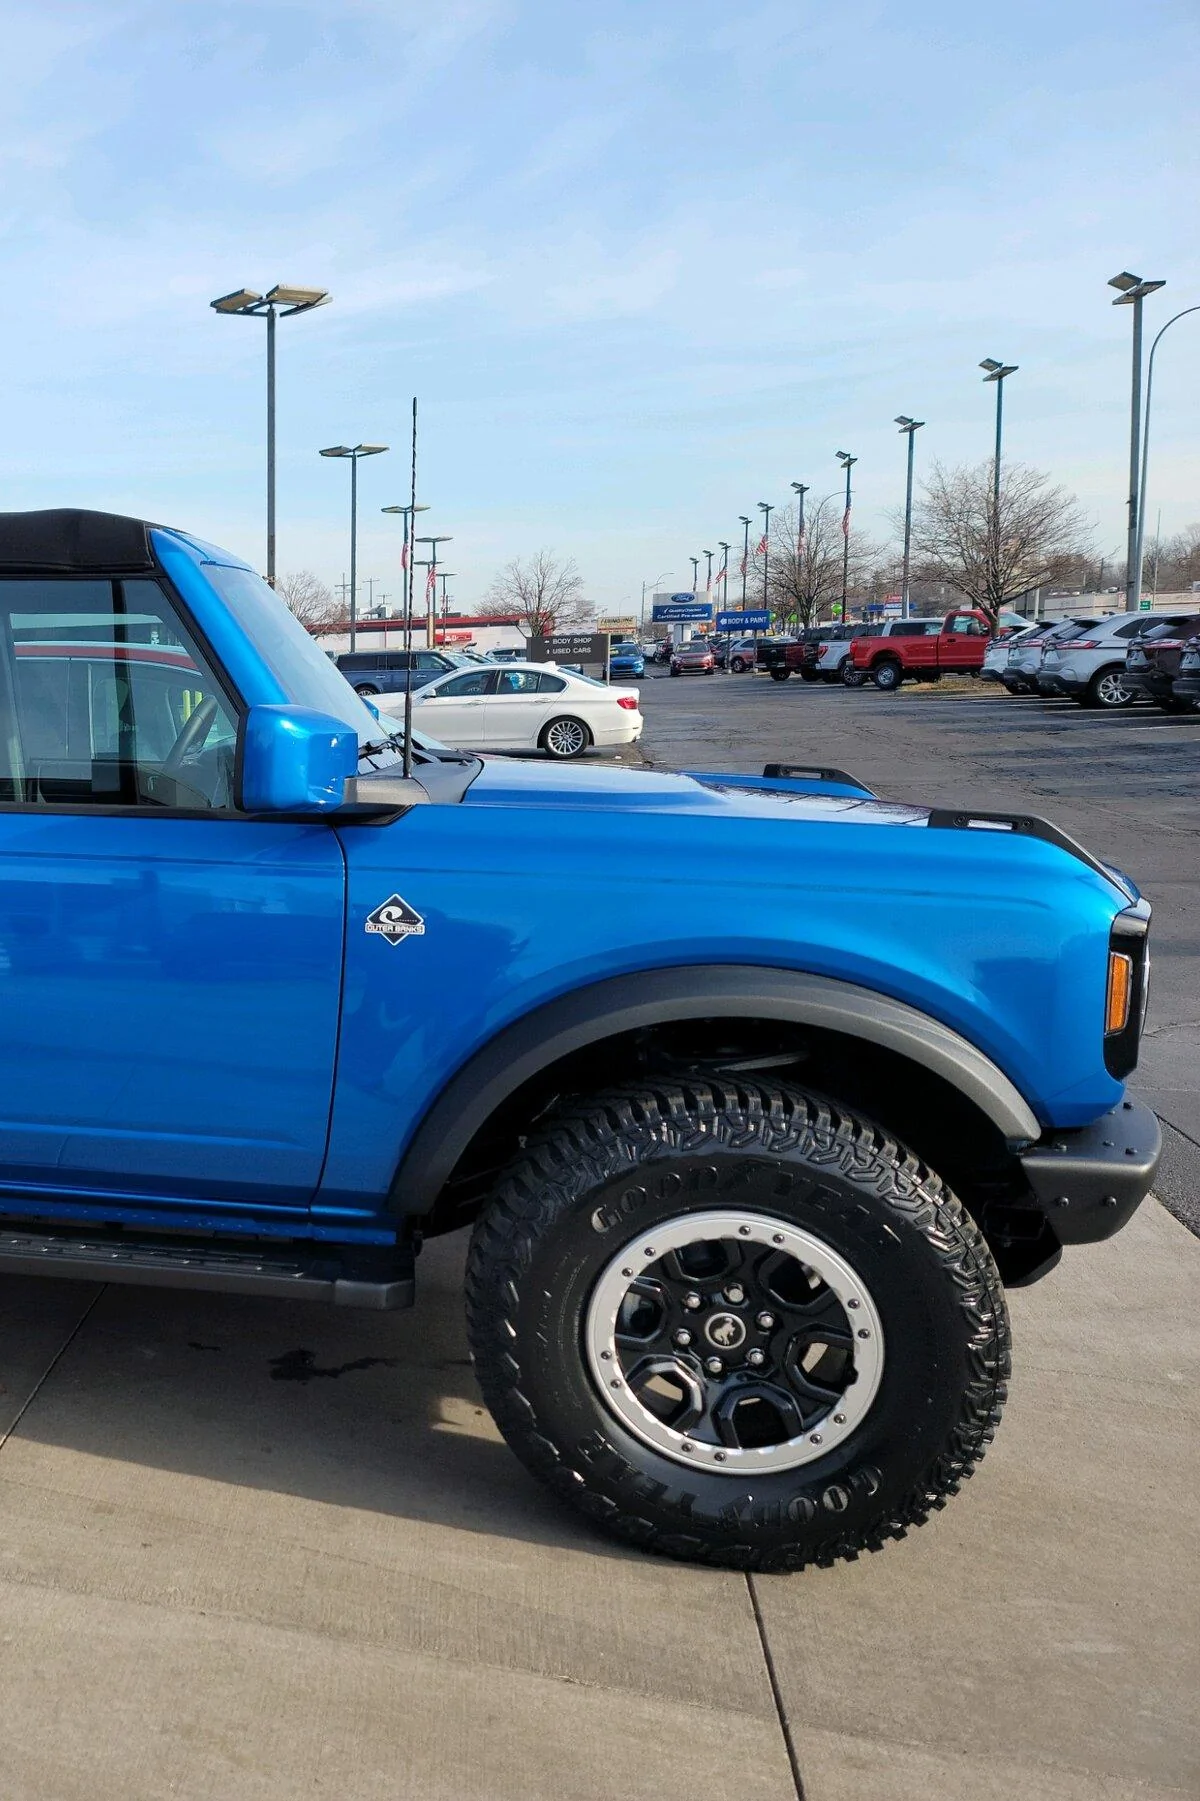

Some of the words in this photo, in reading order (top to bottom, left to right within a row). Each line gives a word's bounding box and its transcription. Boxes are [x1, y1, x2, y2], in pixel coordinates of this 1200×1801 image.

[750, 616, 767, 624] PAINT
[367, 924, 393, 932] OUTER
[395, 925, 422, 933] BANKS
